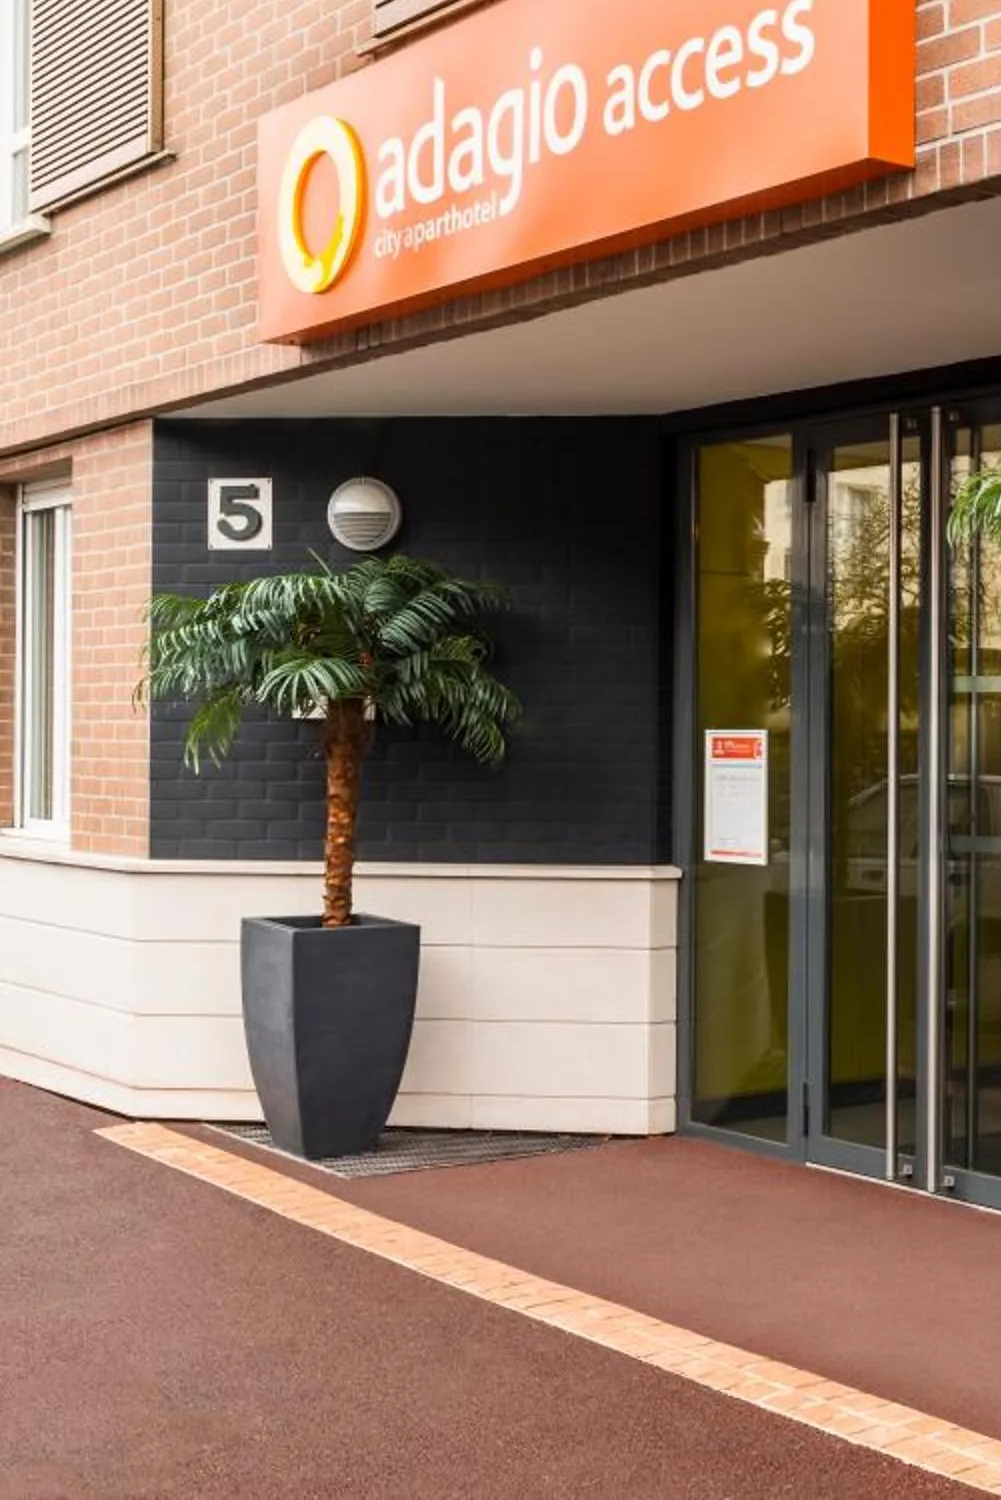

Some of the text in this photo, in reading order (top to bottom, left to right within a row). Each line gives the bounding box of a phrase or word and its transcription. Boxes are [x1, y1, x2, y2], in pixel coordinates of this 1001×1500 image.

[375, 46, 588, 217] adagio
[374, 189, 497, 260] city aparthotel
[217, 483, 263, 541] 5
